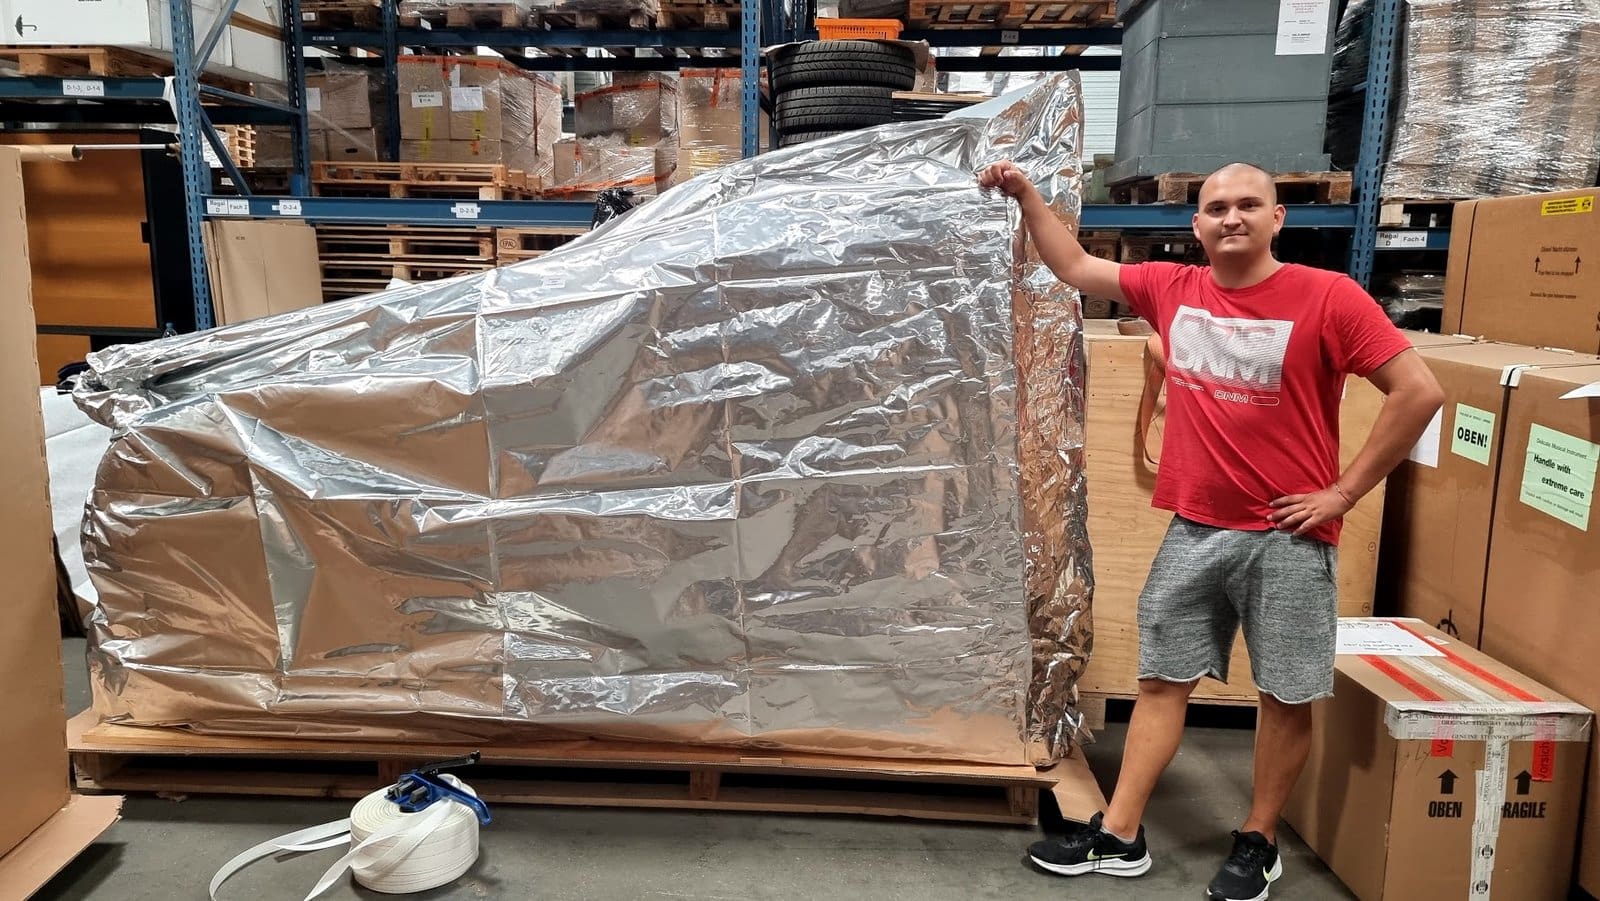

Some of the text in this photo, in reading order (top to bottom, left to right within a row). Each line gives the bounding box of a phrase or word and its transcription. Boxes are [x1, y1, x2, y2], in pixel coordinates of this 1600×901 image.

[1379, 232, 1399, 240] Regal
[1214, 389, 1249, 404] DNM
[1457, 426, 1488, 448] OBEN!
[1551, 443, 1566, 452] Musical
[1566, 448, 1588, 460] Instrument
[1533, 453, 1571, 475] Handle with
[1541, 475, 1585, 499] extreme care
[1428, 800, 1463, 818] OBEN
[1502, 801, 1547, 819] RAGILE
